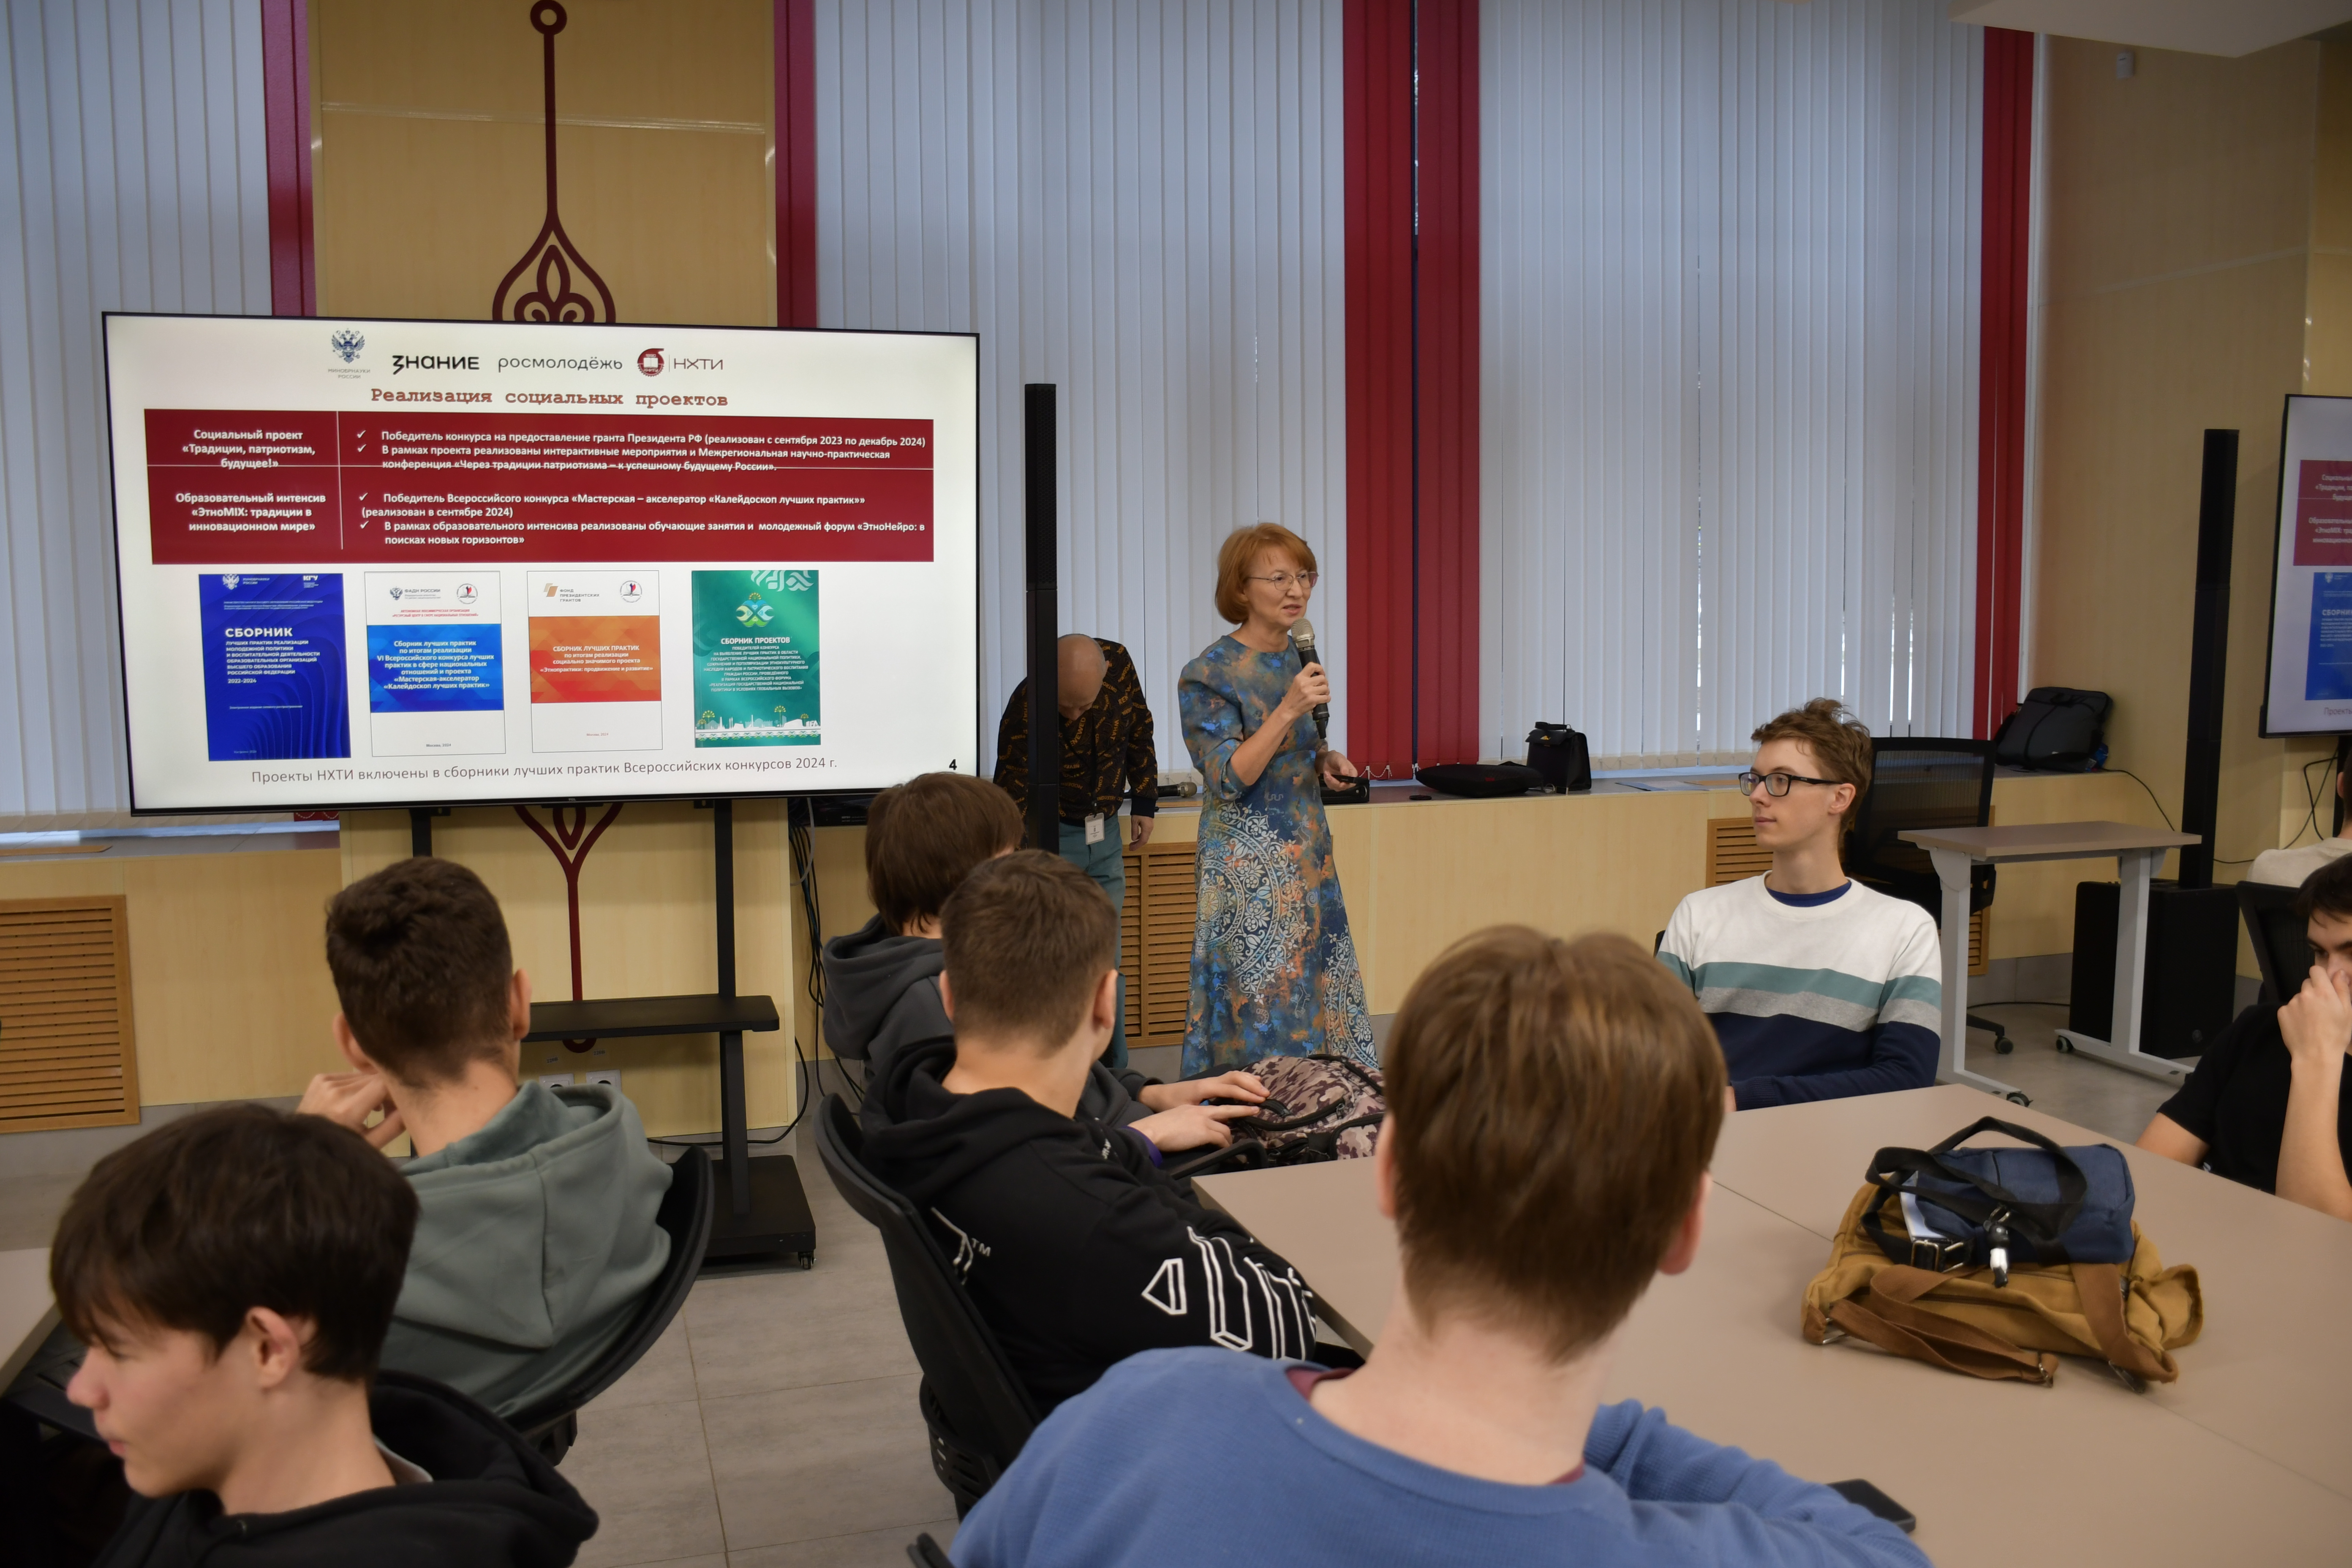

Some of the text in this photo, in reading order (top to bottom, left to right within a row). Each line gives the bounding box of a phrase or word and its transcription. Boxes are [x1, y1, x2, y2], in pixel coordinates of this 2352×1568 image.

[498, 357, 622, 372] росмолодёжь
[674, 358, 722, 369] НХТИ
[371, 389, 727, 408] Реализация социальных проектов
[193, 430, 303, 441] Социальный проект
[381, 431, 443, 441] Победитель
[446, 434, 491, 442] конкурса
[509, 434, 590, 442] предоставление
[593, 435, 625, 443] гранта
[628, 433, 686, 444] Президента
[688, 434, 702, 442] РФ
[705, 434, 765, 444] (реализован
[774, 436, 817, 445] сентября
[820, 436, 842, 444] 2023
[858, 437, 897, 446] декабрь
[900, 437, 925, 447] 2024)
[182, 444, 315, 455] «Традиции, патриотизм,
[382, 445, 389, 454] В
[391, 447, 428, 455] рамках
[430, 447, 471, 455] проекта
[622, 449, 687, 457] мероприятия
[698, 448, 788, 457] Межрегиональная
[220, 458, 278, 469] будущее!»
[382, 460, 451, 470] конференция
[454, 460, 490, 470] «Через
[492, 462, 541, 470] традиции
[543, 462, 607, 470] патриотизма
[626, 463, 681, 471] успешному
[683, 461, 732, 471] будущему
[735, 462, 776, 470] России».
[176, 493, 274, 503] Образовательный
[384, 493, 444, 504] Победитель
[447, 494, 521, 504] Всероссийсого
[524, 496, 569, 504] конкурса
[572, 494, 635, 504] «Мастерская
[646, 496, 706, 504] акселератор
[709, 495, 776, 504] «Калейдоскоп
[250, 509, 302, 518] традиции
[362, 507, 425, 517] (реализован
[436, 507, 482, 517] сентябре
[485, 507, 513, 517] 2024)
[189, 523, 315, 532] инновационном мире»
[384, 522, 391, 530] В
[394, 523, 430, 531] рамках
[433, 522, 524, 531] образовательного
[648, 522, 705, 531] обучающие
[759, 522, 821, 531] молодежный
[824, 522, 855, 532] форум
[857, 522, 917, 532] «ЭтноНейро:
[462, 537, 524, 545] горизонтов»
[225, 628, 292, 637] СБОРНИК
[1110, 719, 1119, 740] WHAT
[949, 759, 957, 770] 4
[252, 771, 312, 784] Проекты
[317, 769, 353, 780] НХТИ
[359, 770, 427, 779] включены
[444, 766, 509, 779] сборники
[514, 767, 563, 777] лучших
[567, 765, 619, 776] практик
[624, 761, 721, 773] Всероссийских
[726, 761, 791, 771] конкурсов
[796, 757, 825, 768] 2024
